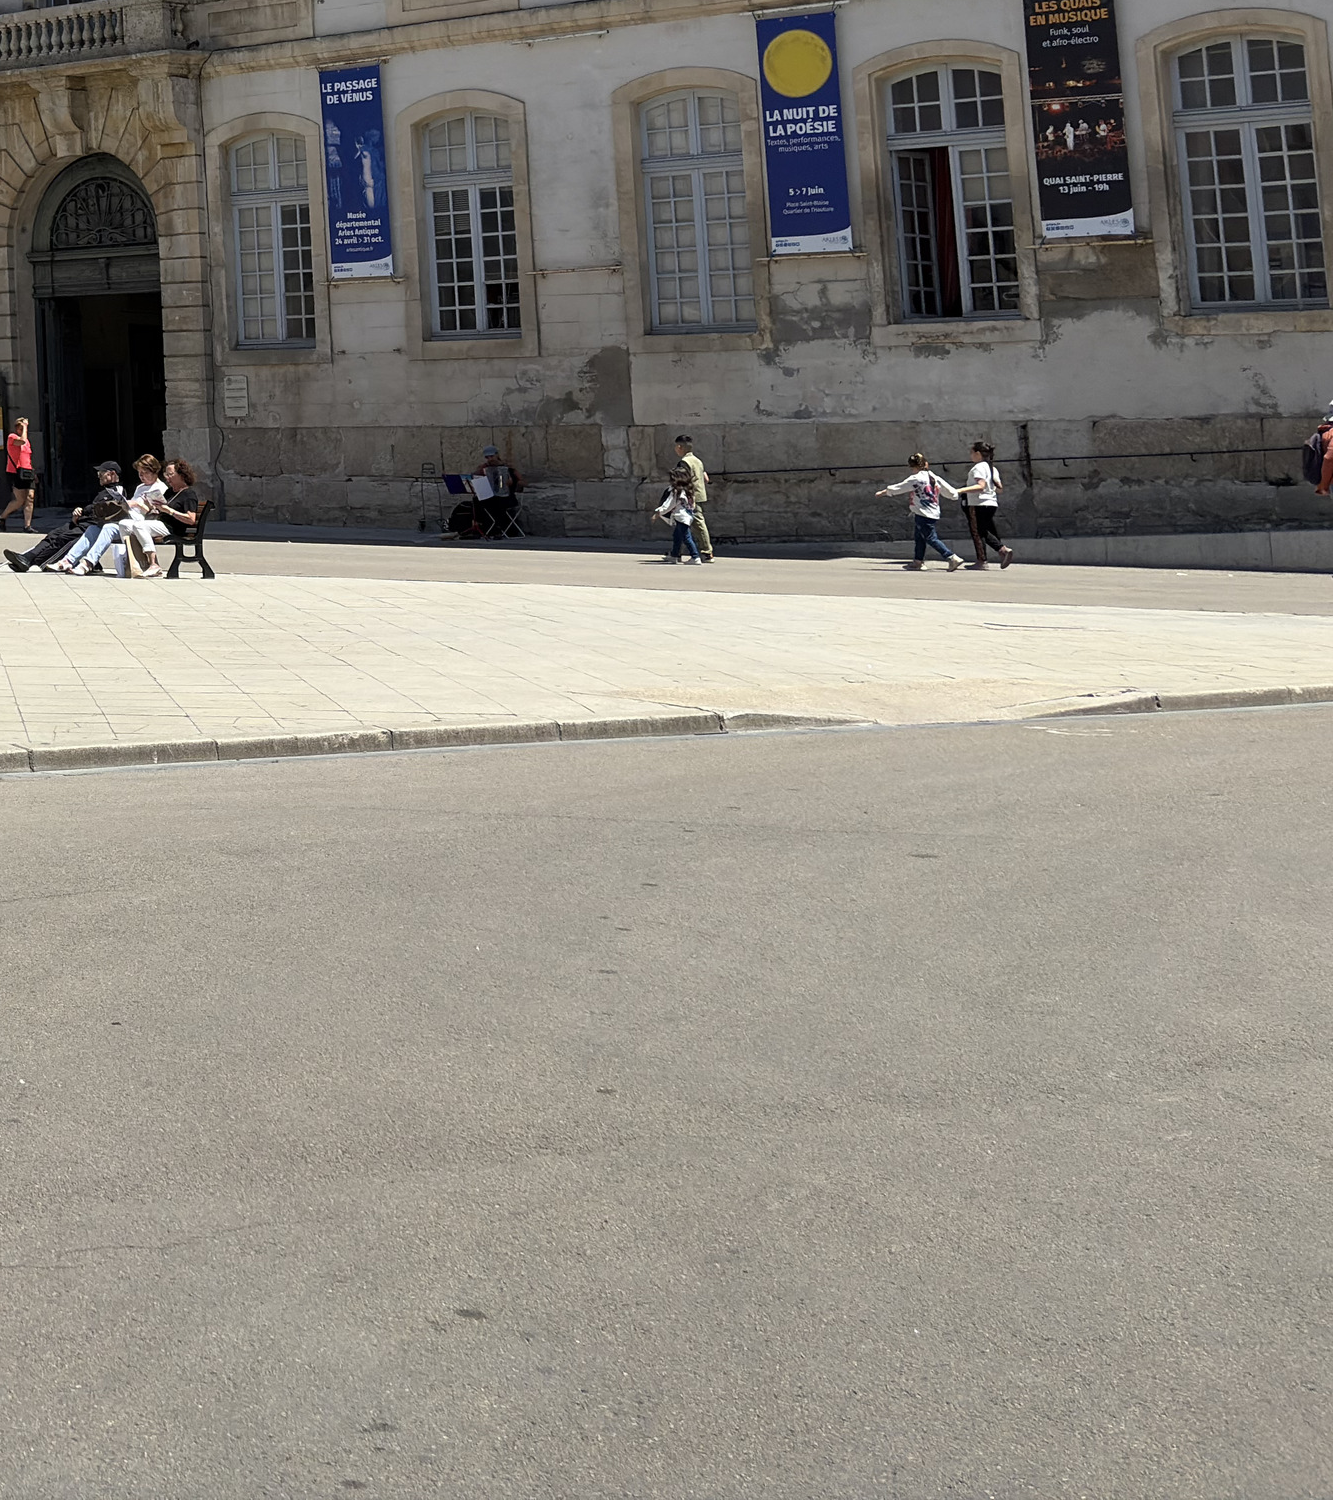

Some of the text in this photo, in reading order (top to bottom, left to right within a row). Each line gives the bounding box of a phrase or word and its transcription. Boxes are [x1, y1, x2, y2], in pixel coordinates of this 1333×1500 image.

[1035, 1, 1057, 12] LES
[1030, 8, 1109, 26] EN MUSIQUE
[1050, 24, 1089, 35] Funk, soul
[1052, 36, 1099, 46] afro-électro
[322, 78, 377, 92] LE PASSAGE
[327, 91, 373, 104] DE VÉNUS
[766, 105, 838, 121] LA NUIT DE
[769, 119, 836, 136] LA POÉSIE
[790, 136, 841, 145] performances,
[1043, 173, 1124, 185] QUAI SAINT-PIERRE
[1070, 184, 1086, 194] juin
[1094, 183, 1109, 191] 19h
[336, 219, 381, 229] départemental
[355, 227, 379, 236] Antique
